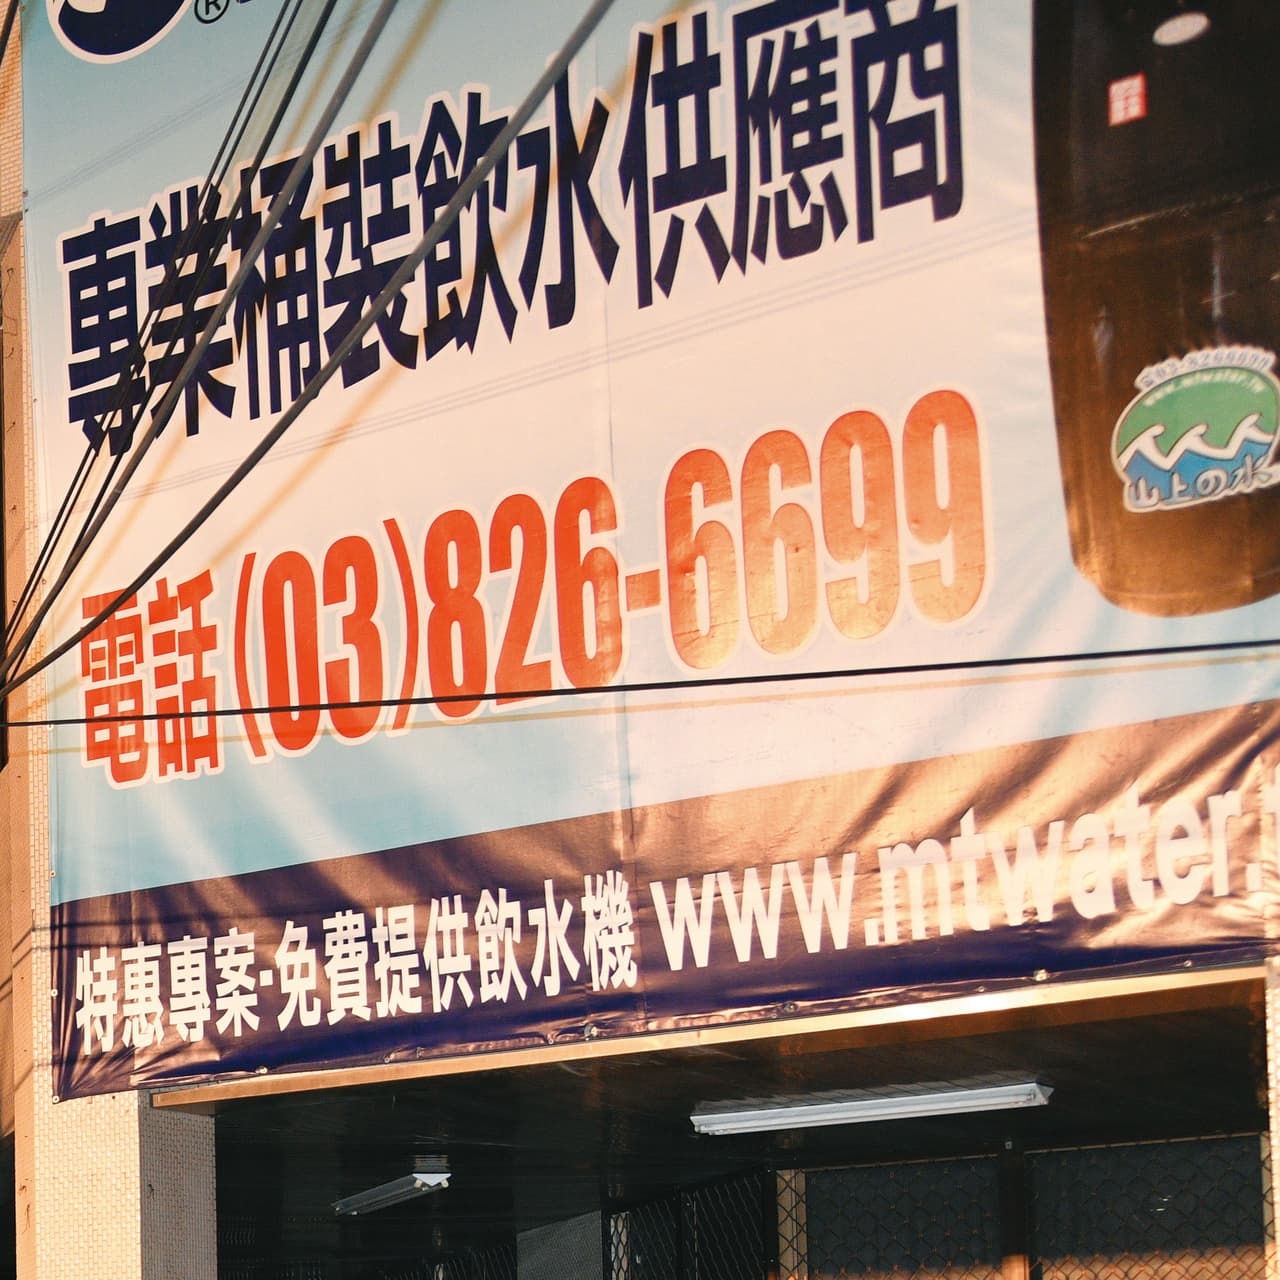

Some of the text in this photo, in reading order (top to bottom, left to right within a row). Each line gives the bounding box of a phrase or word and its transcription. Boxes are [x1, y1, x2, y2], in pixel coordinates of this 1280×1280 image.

[61, 0, 964, 456] 專業桶裝飲水供應商
[81, 567, 220, 784] 電話
